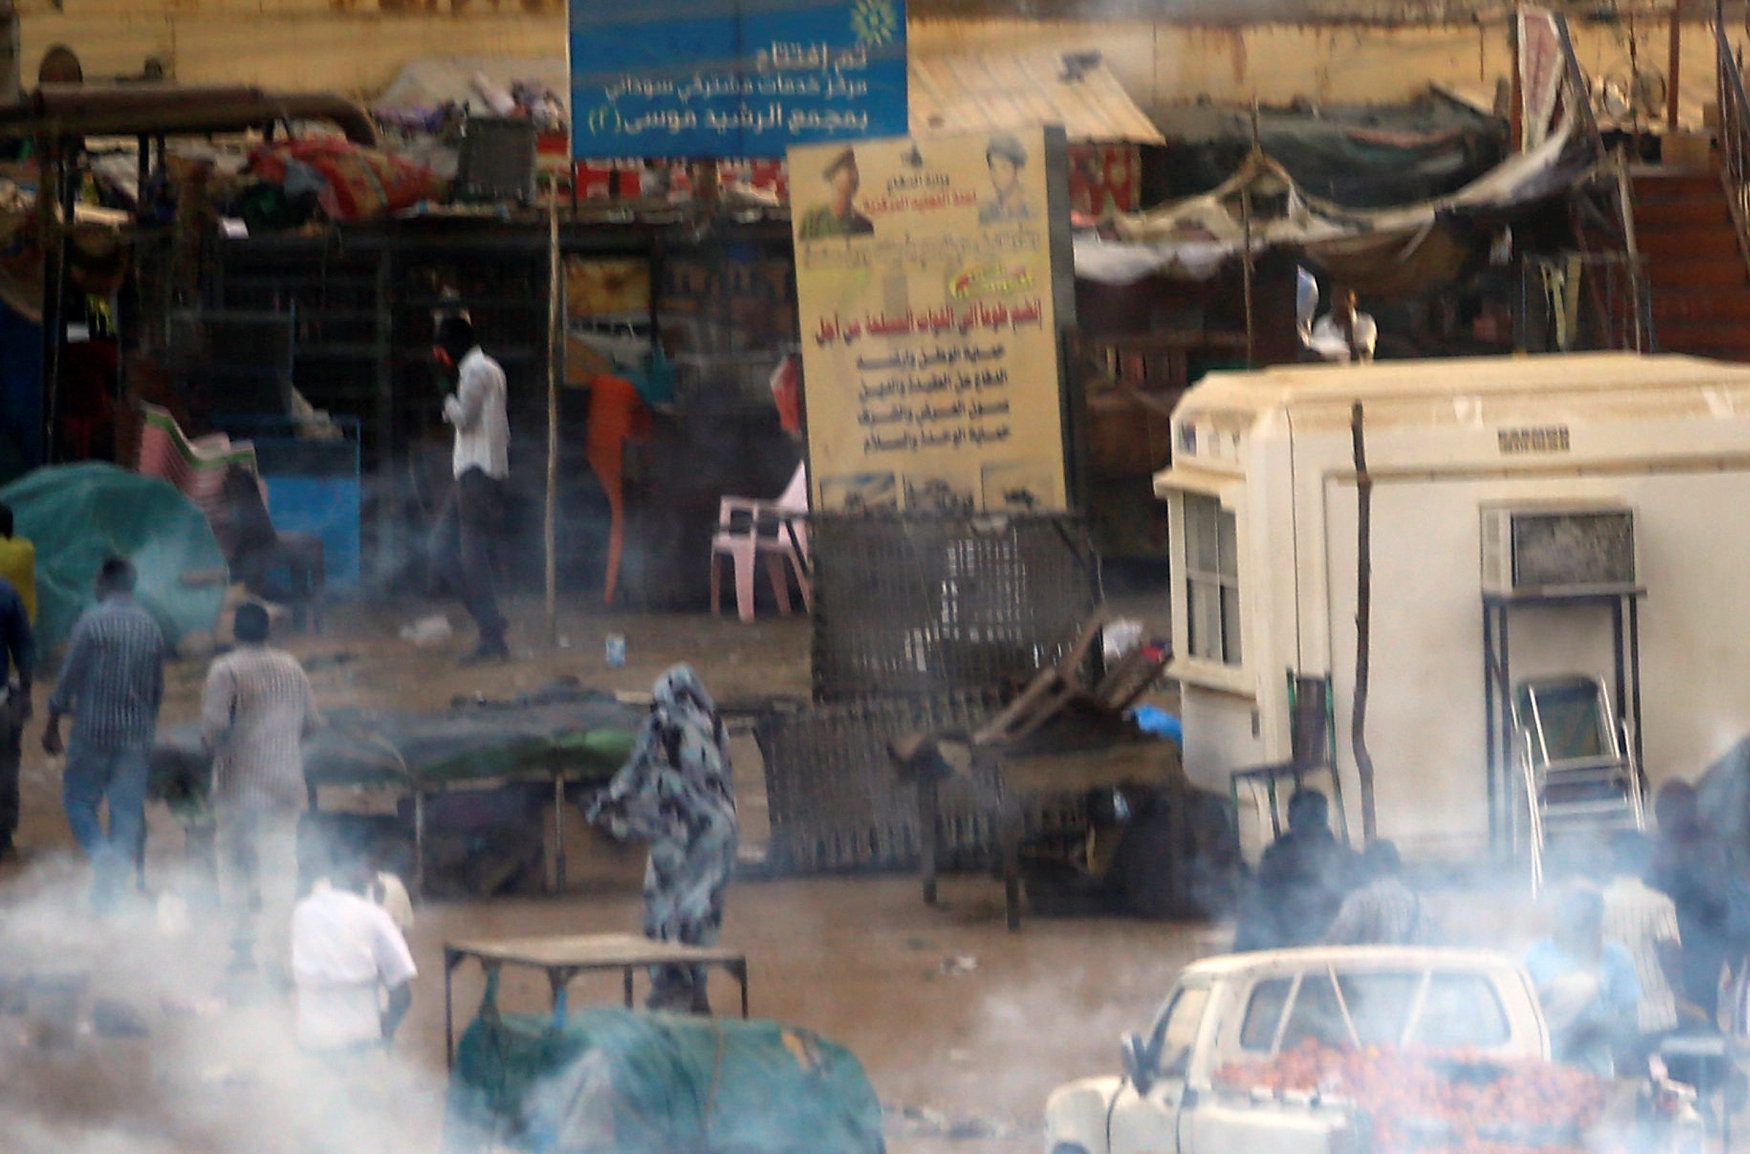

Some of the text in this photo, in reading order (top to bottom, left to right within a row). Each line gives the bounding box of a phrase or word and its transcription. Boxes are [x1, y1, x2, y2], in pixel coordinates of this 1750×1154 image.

[758, 73, 820, 96] خدمات
[827, 72, 868, 98] مركز
[706, 101, 783, 136] الرشيد
